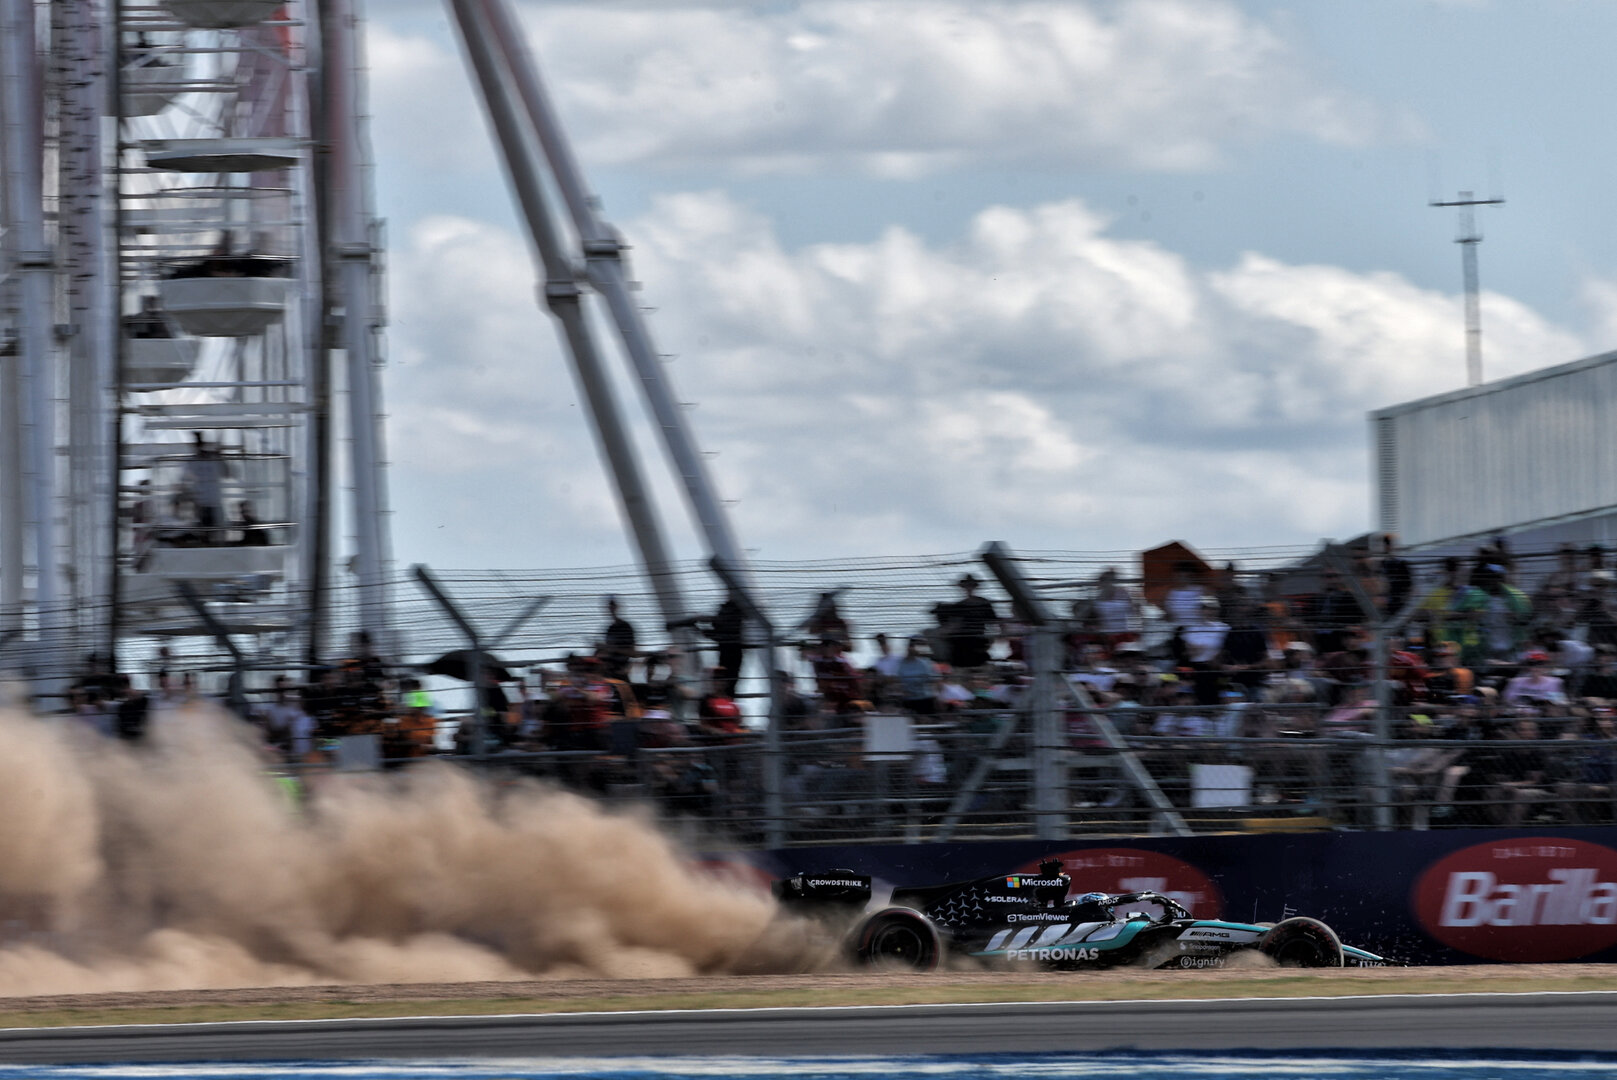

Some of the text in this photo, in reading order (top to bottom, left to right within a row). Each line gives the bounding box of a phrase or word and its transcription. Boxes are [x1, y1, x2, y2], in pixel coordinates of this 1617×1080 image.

[1021, 878, 1063, 886] Microsoft
[1440, 868, 1617, 927] Bara
[1017, 913, 1069, 921] TeamViewer
[1007, 947, 1099, 961] PETRONAS
